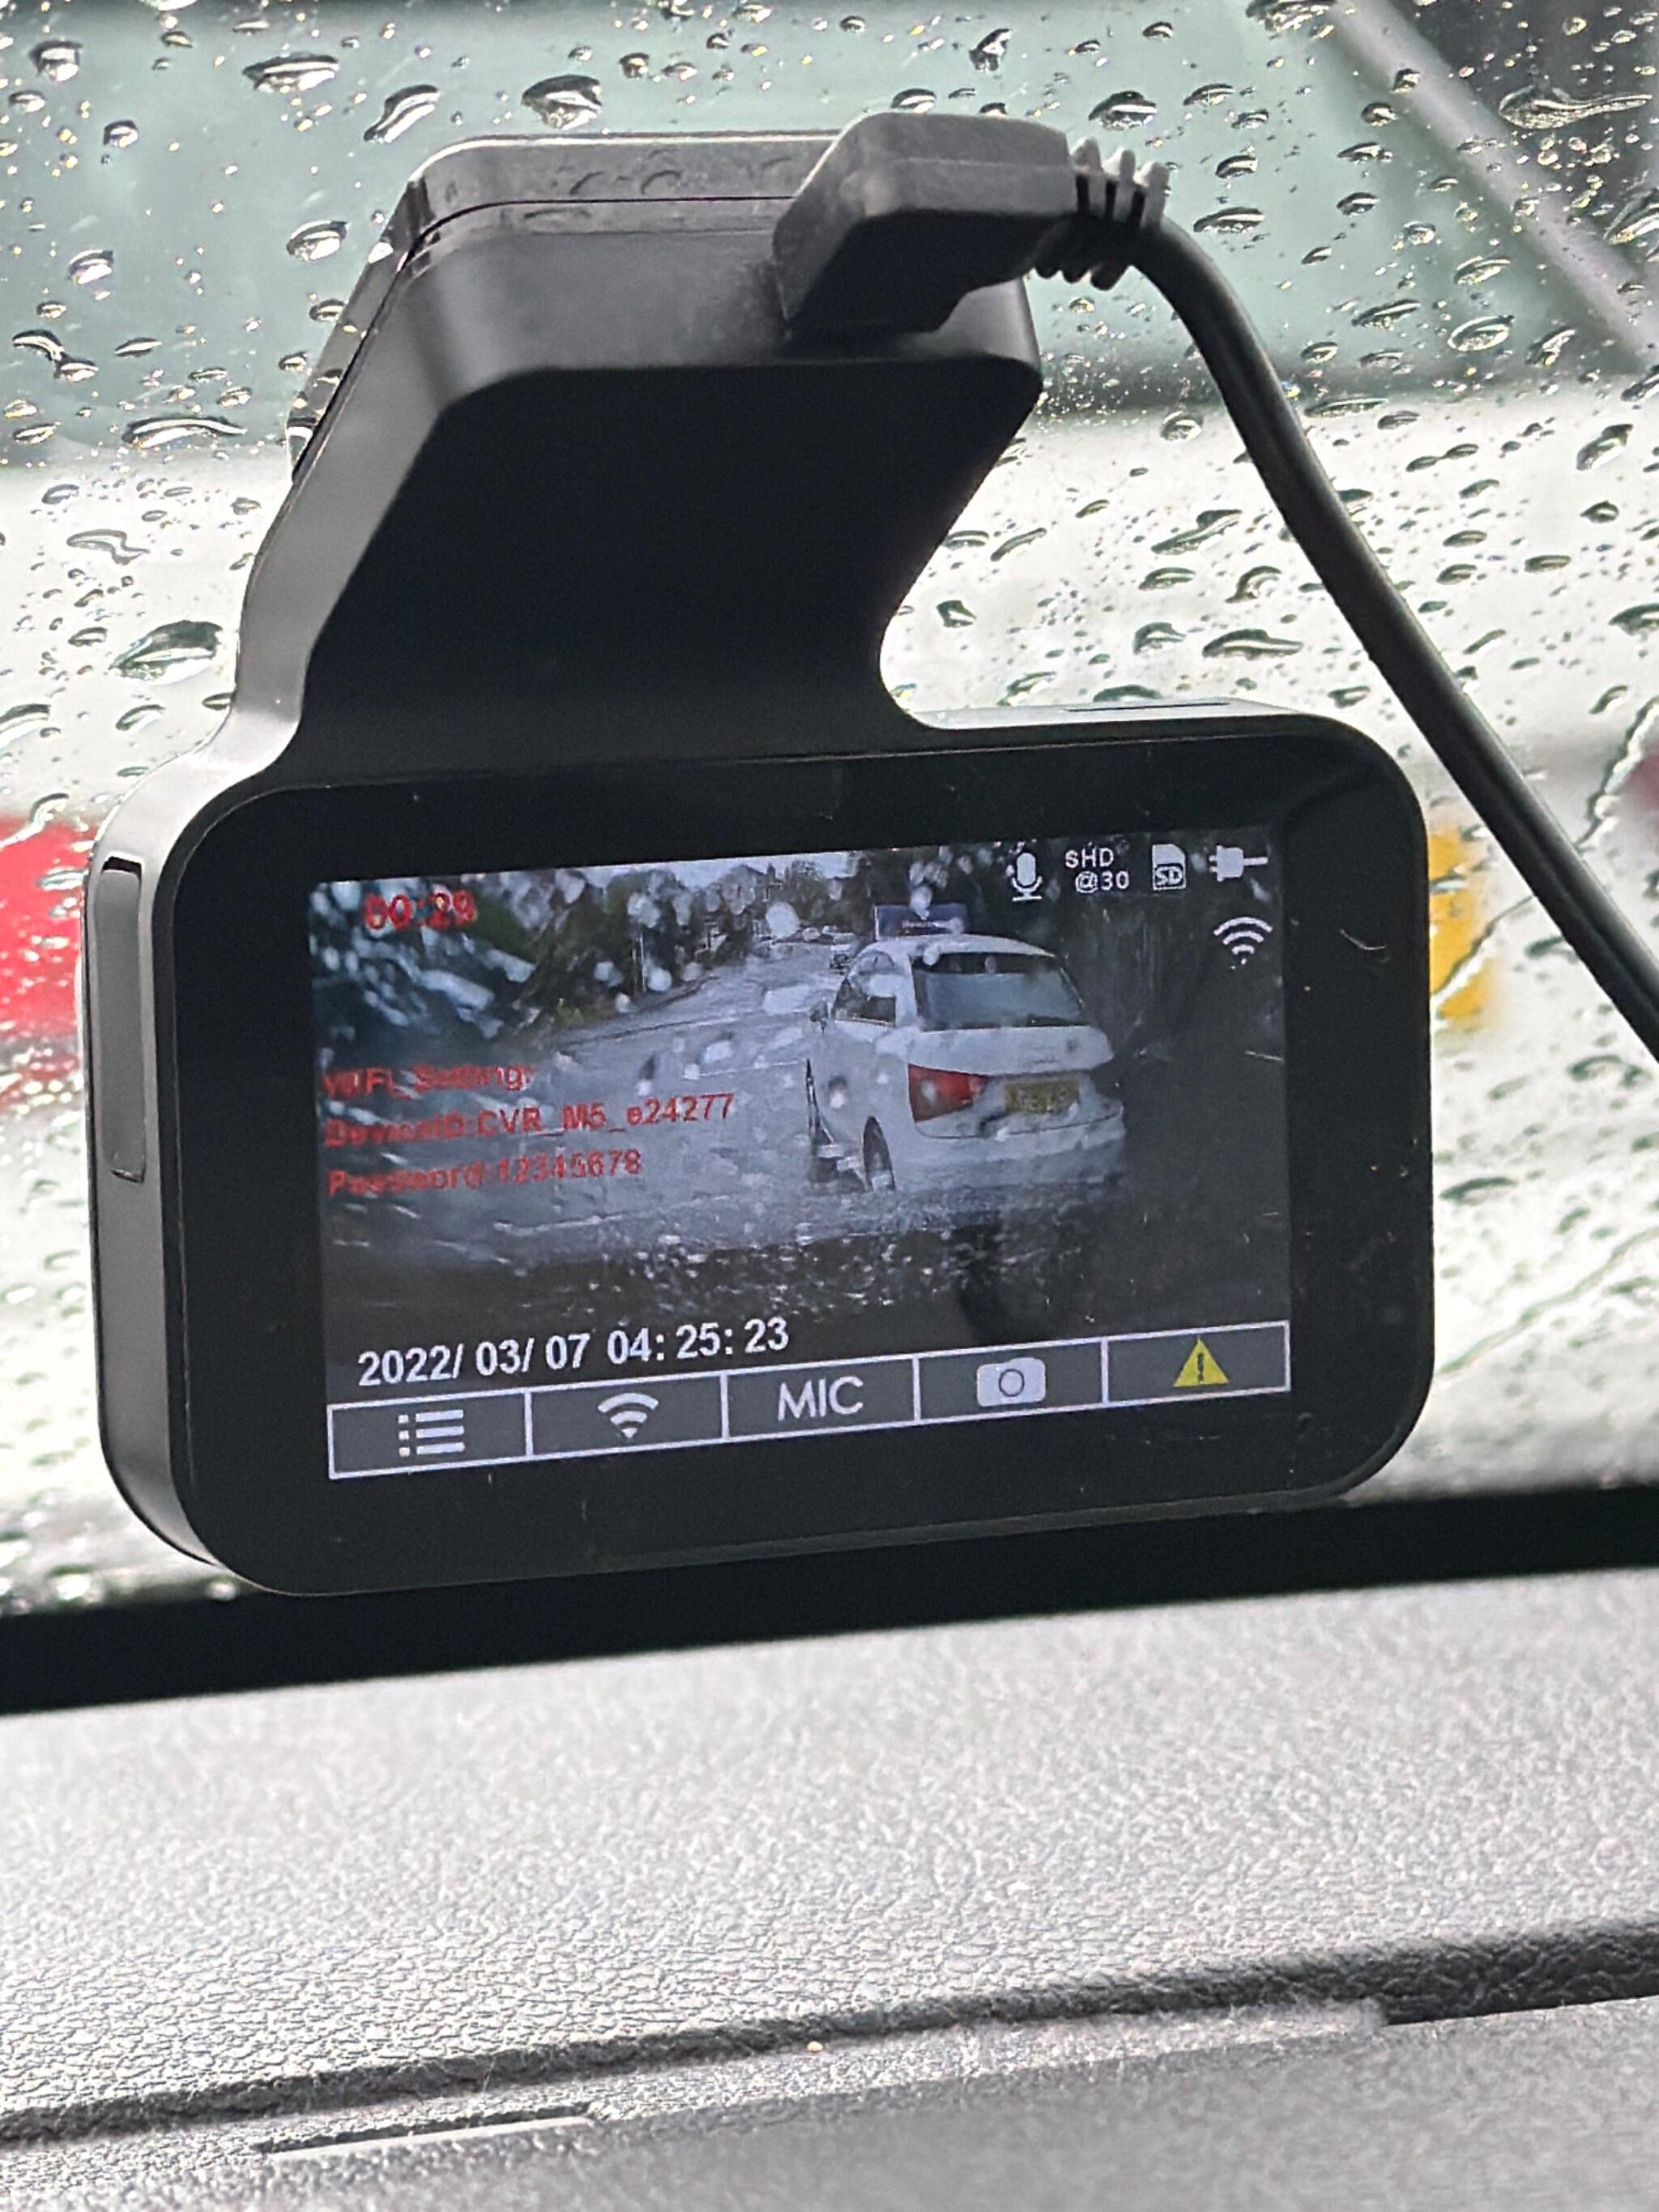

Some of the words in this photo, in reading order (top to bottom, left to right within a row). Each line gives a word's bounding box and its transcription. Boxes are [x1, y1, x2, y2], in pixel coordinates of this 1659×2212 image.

[1065, 848, 1115, 869] SHD
[1075, 870, 1130, 894] @30
[1154, 865, 1183, 886] SD
[545, 1333, 591, 1371] 07
[744, 1316, 790, 1354] 23
[777, 1375, 865, 1421] MIC
